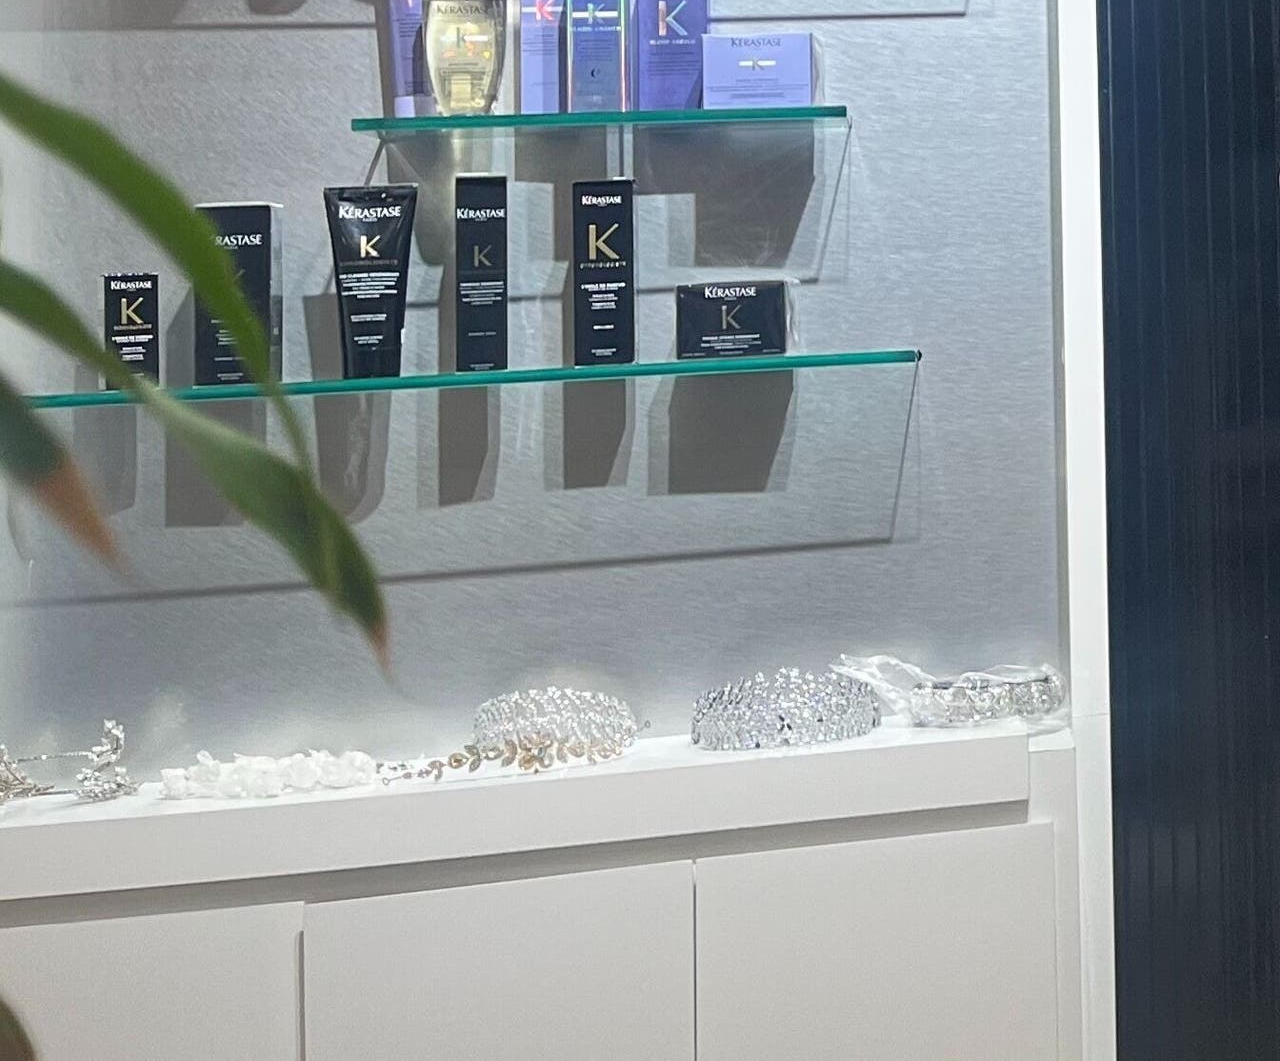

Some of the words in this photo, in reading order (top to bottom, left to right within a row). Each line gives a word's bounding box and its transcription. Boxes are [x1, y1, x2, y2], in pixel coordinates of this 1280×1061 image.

[658, 0, 688, 36] K
[581, 195, 623, 205] KÉRASTASE
[338, 205, 402, 219] KÉRASTASE
[456, 208, 506, 220] KÉRASTASE
[214, 234, 262, 246] RASTASE
[360, 234, 381, 258] K
[588, 223, 620, 260] K
[473, 244, 493, 267] K
[704, 285, 757, 298] KÉRASTASE
[121, 297, 144, 325] K
[721, 304, 742, 330] K
